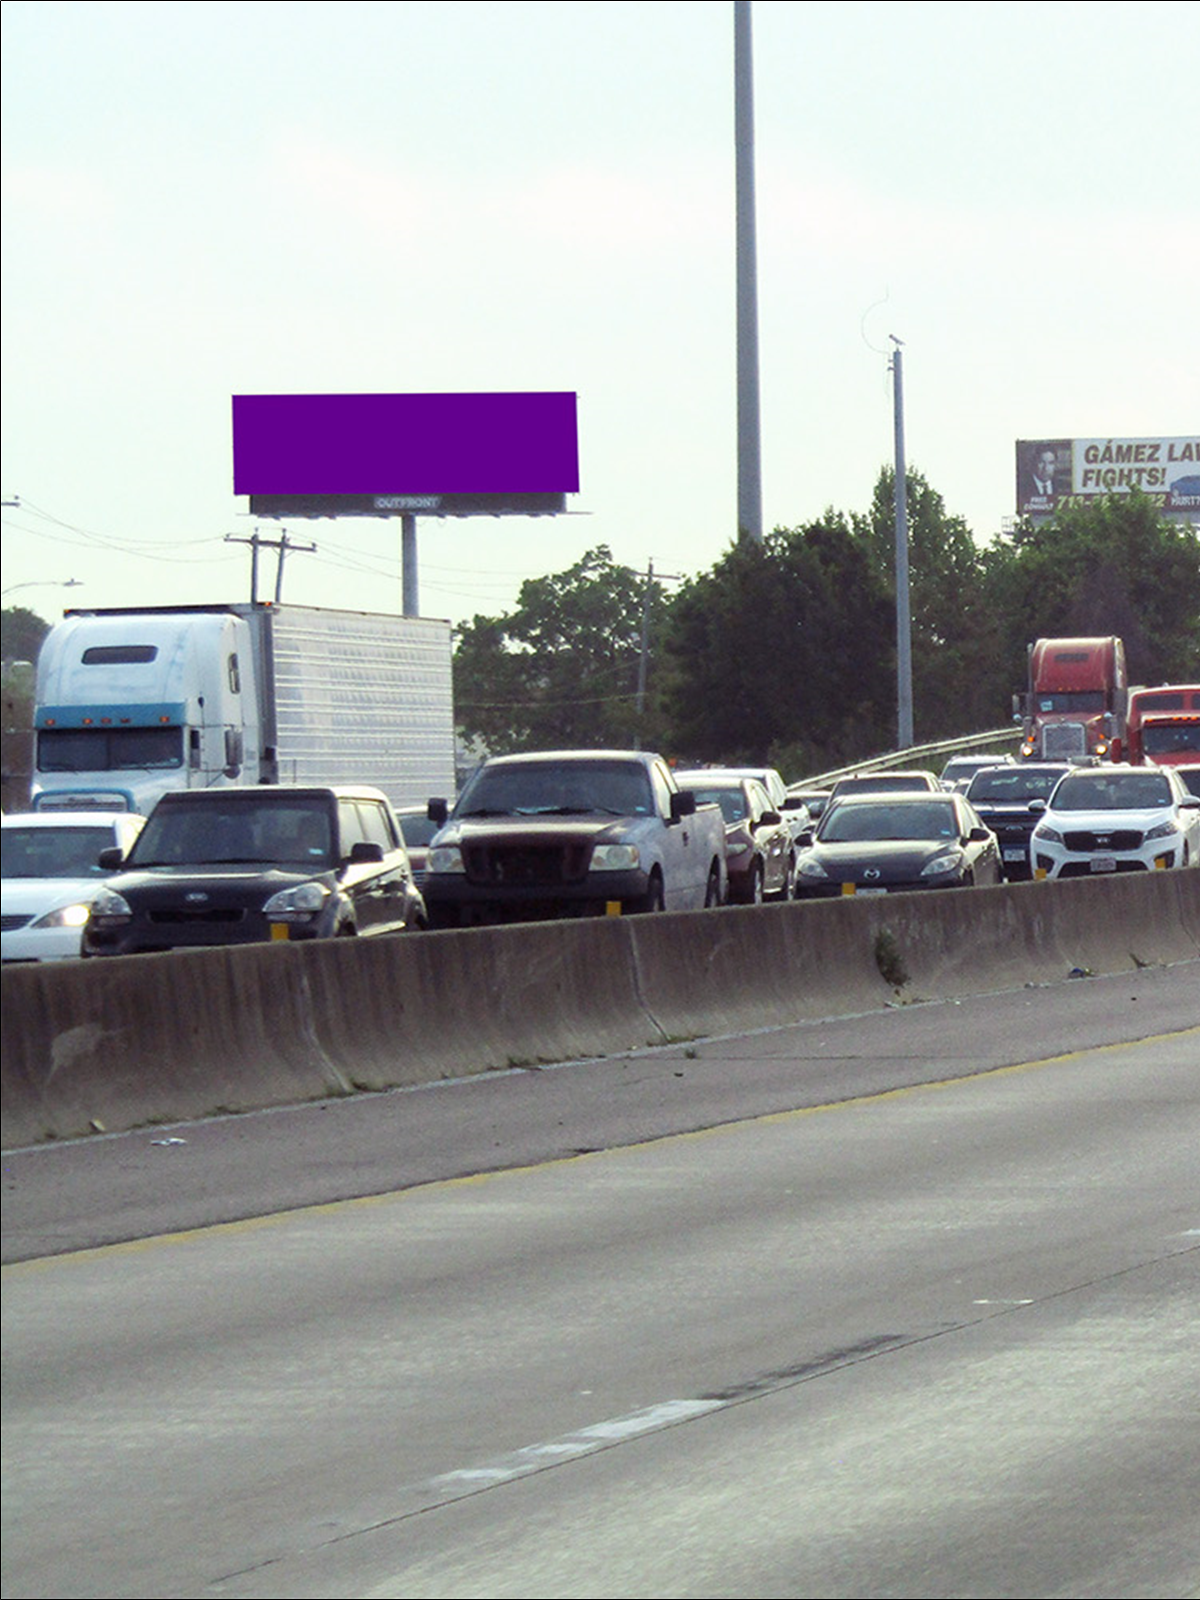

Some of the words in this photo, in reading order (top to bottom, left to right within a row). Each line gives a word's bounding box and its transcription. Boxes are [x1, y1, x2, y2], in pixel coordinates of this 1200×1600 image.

[1084, 440, 1161, 464] GÁMEZ
[1082, 467, 1167, 488] FIGHTS!
[377, 496, 440, 509] OUTFRONT
